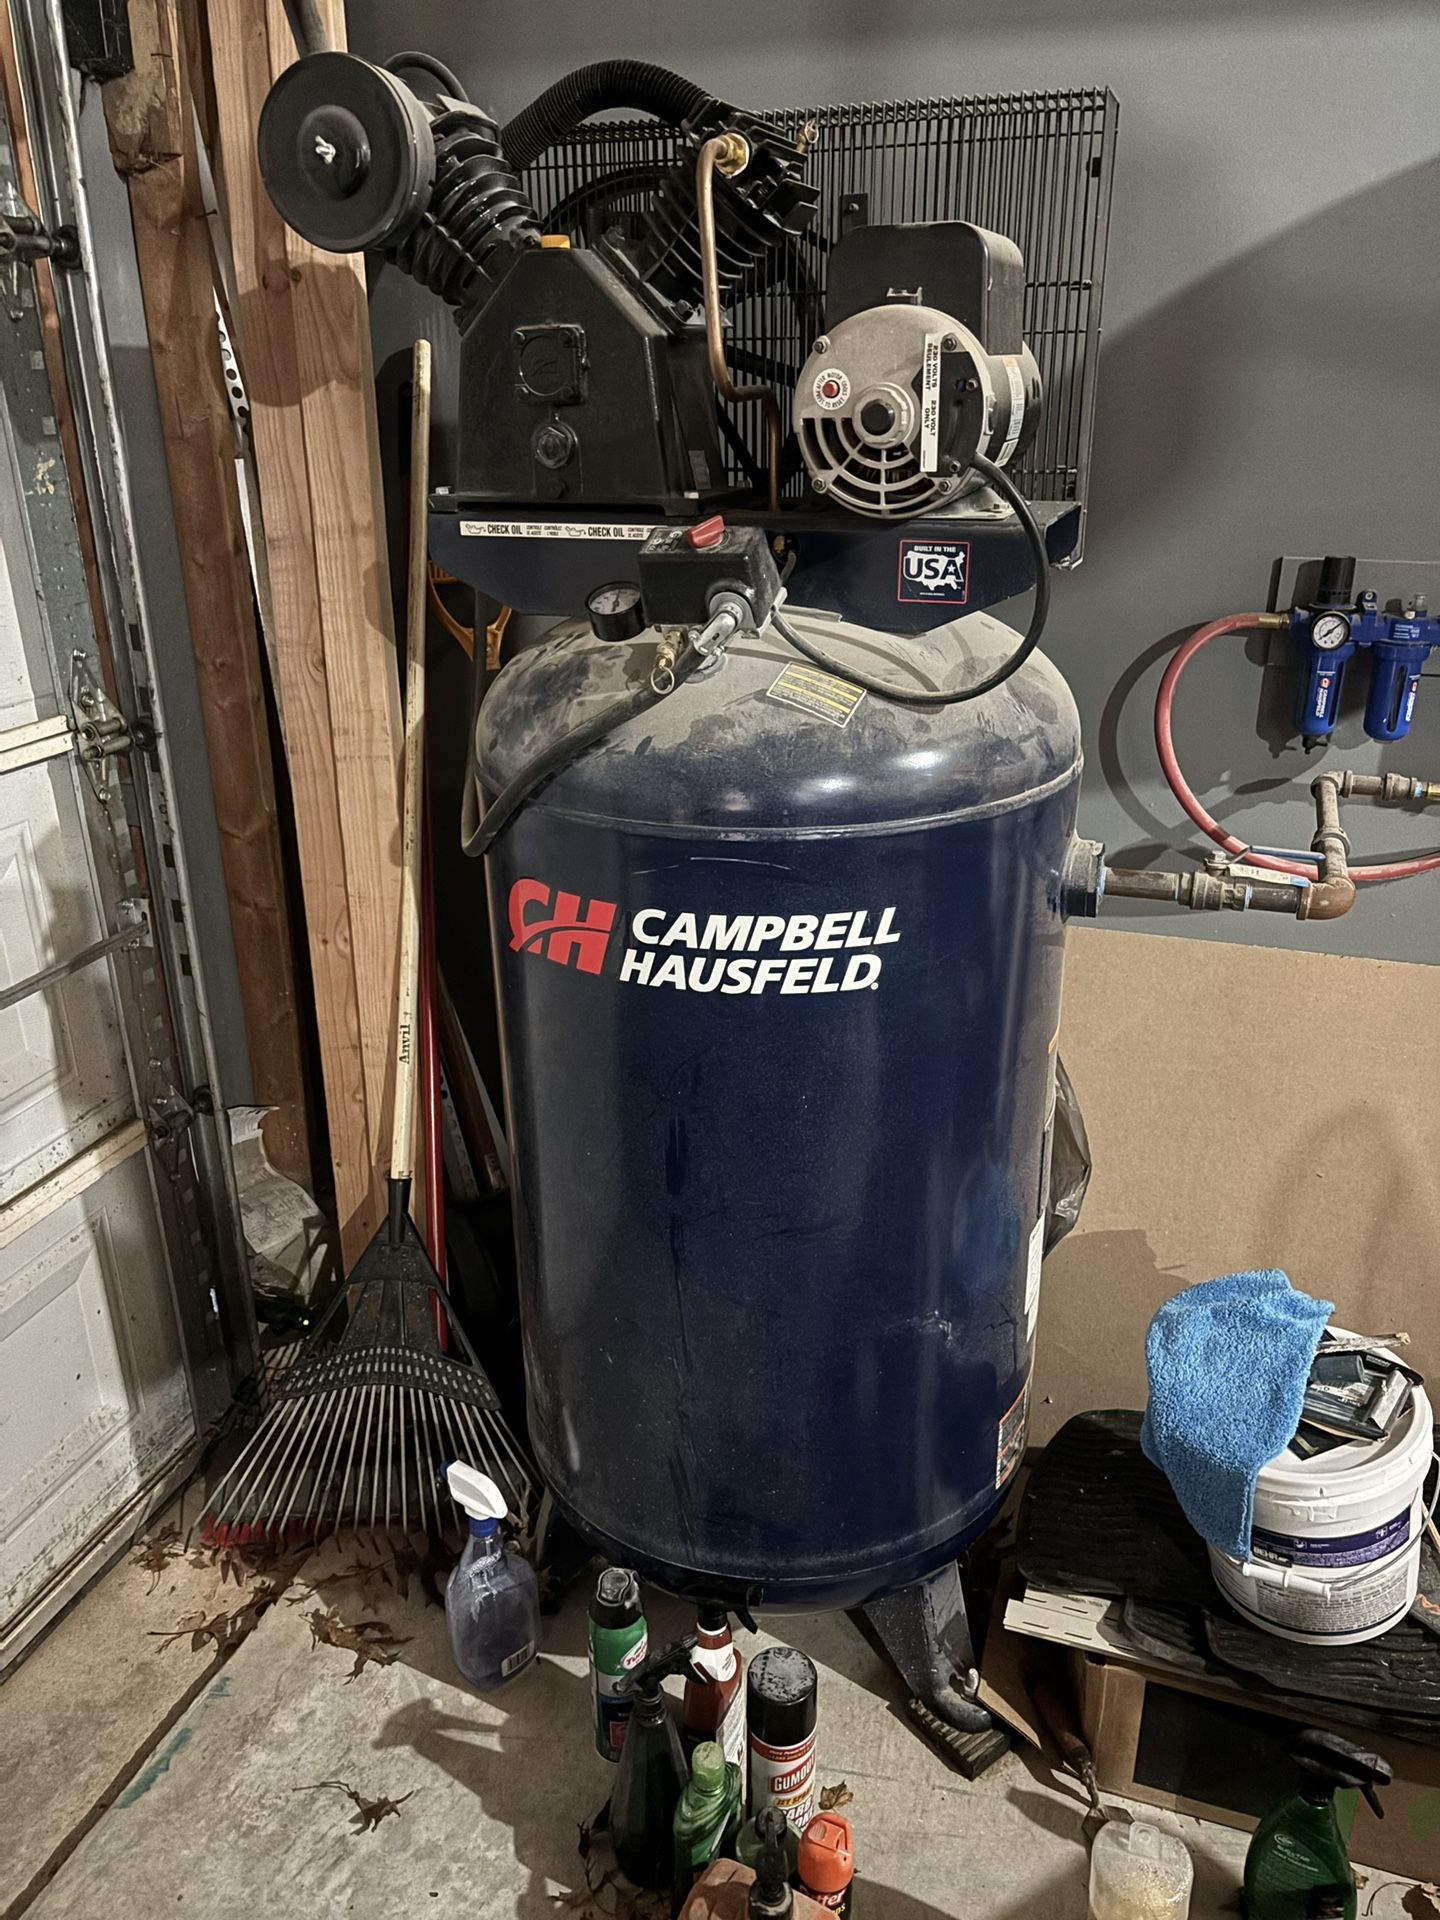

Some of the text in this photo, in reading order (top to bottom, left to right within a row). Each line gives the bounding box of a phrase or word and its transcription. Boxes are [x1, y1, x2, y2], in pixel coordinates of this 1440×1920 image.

[925, 343, 933, 390] SEULEMENT
[487, 524, 510, 534] CHECK
[511, 525, 523, 535] OIL
[588, 527, 611, 537] CHECK
[613, 527, 625, 537] OIL
[904, 557, 962, 581] USA
[631, 906, 901, 952] CAMPBELL
[399, 1024, 410, 1064] Anvil
